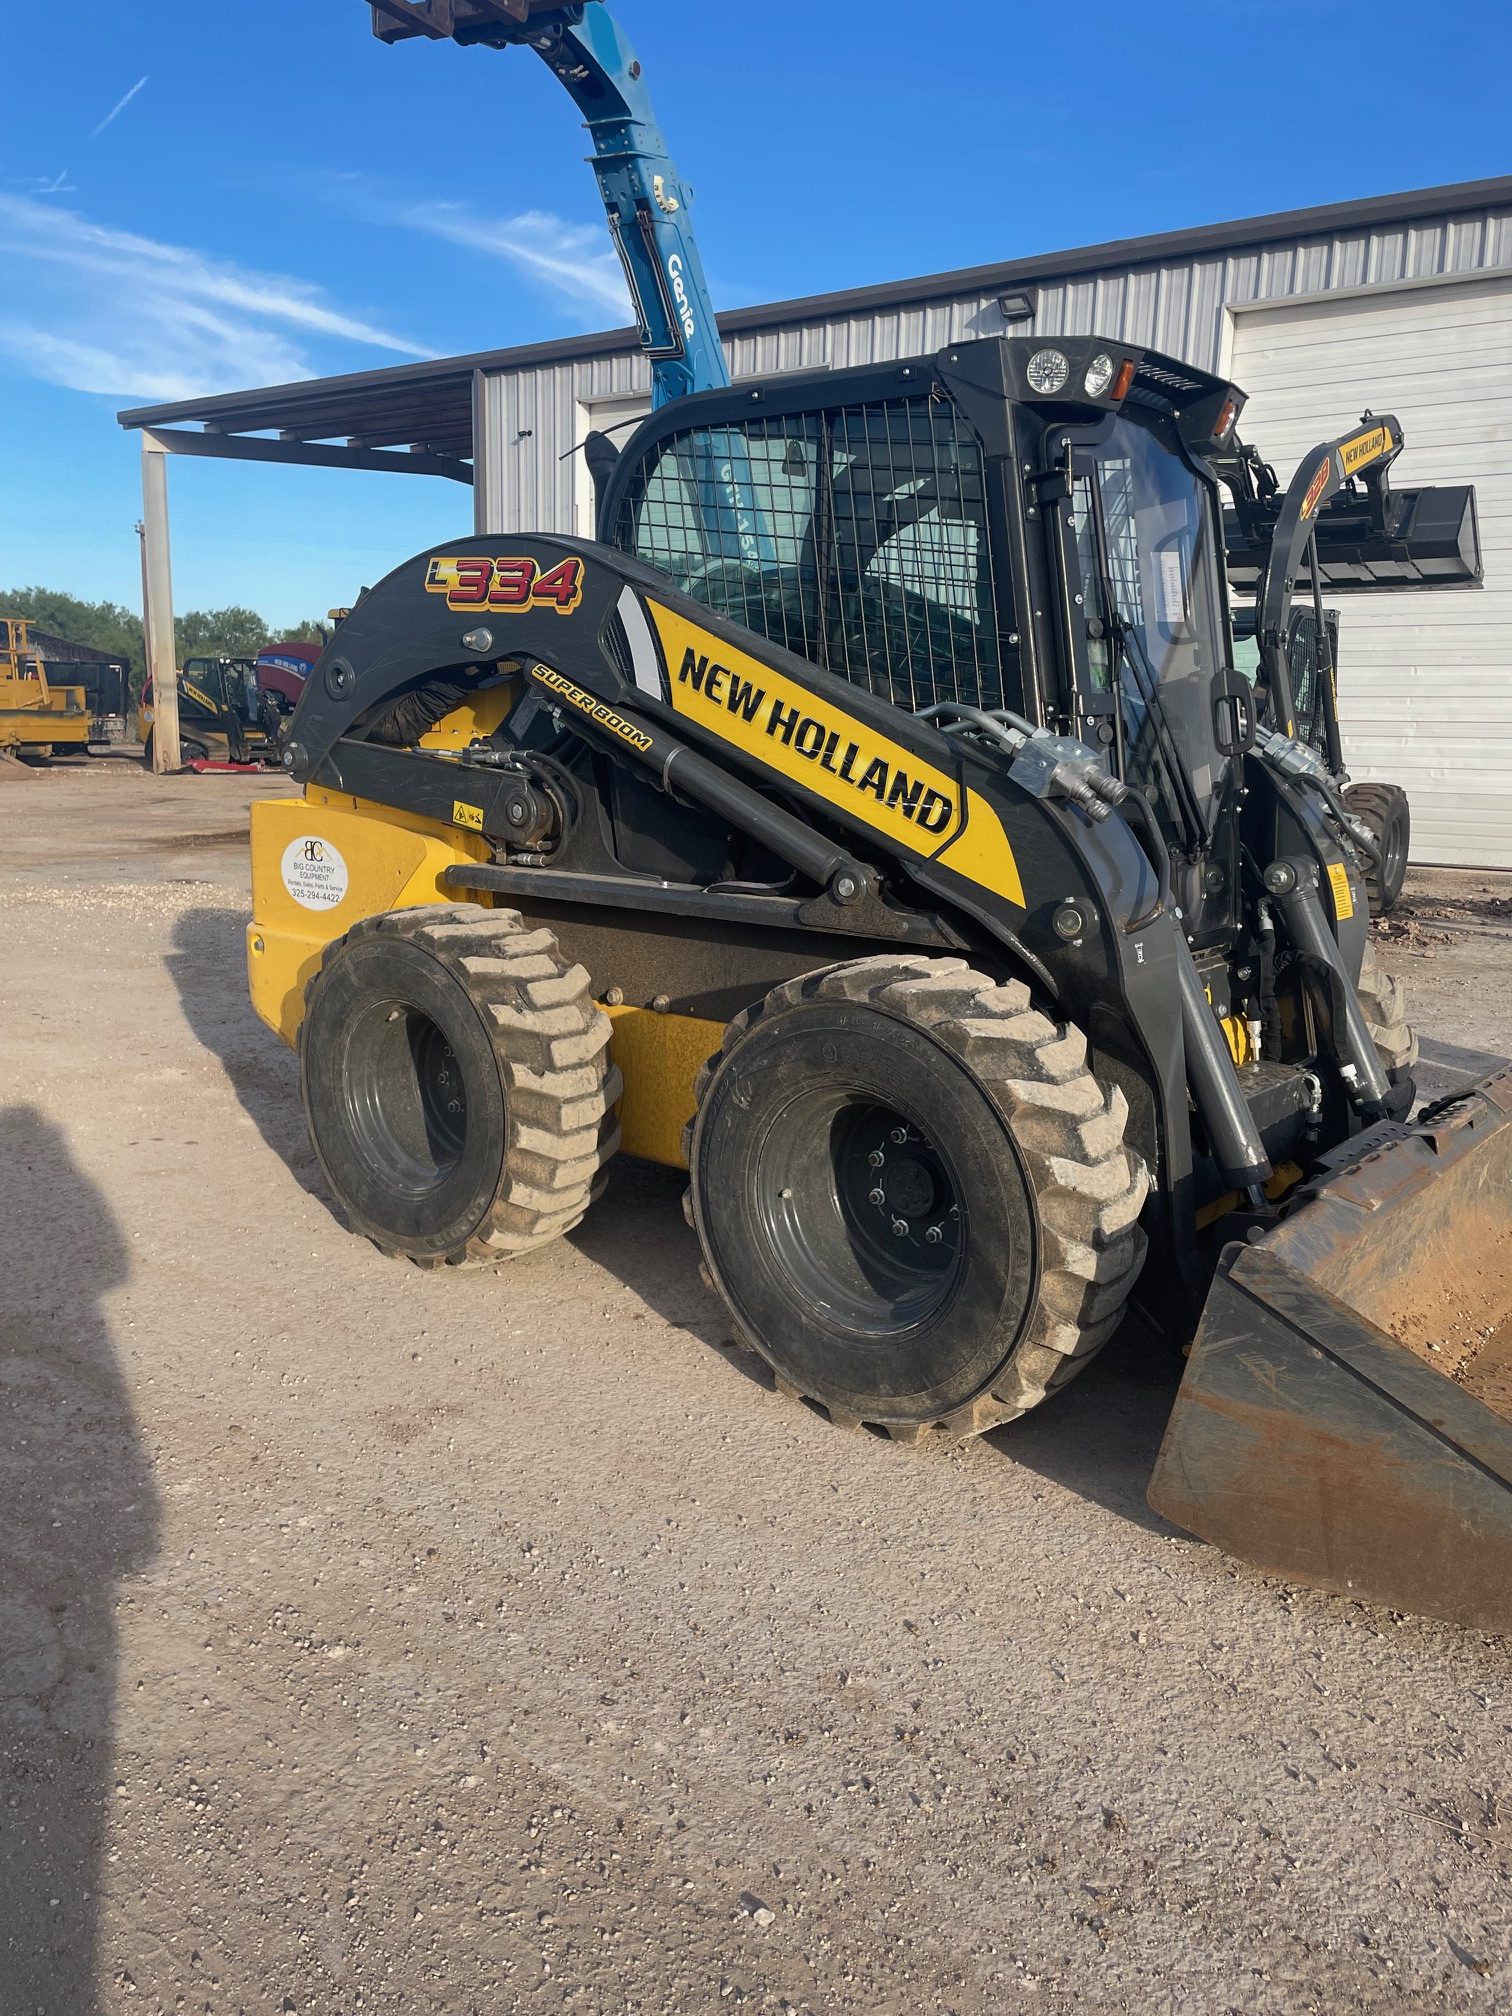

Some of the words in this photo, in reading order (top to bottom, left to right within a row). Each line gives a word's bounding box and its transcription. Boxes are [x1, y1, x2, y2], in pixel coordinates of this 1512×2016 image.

[668, 253, 695, 340] Genie
[1345, 446, 1358, 466] NEW
[1358, 433, 1383, 455] HOLLAND
[425, 558, 584, 614] L334
[532, 663, 597, 713] SUPER
[592, 704, 654, 752] BOOM
[677, 645, 767, 725] NEW
[764, 698, 953, 835] HOLLAND
[293, 862, 304, 871] BIG
[304, 863, 335, 874] COUNTRY
[299, 872, 329, 881] EQUIPMENT
[292, 888, 340, 903] 325-294-4422
